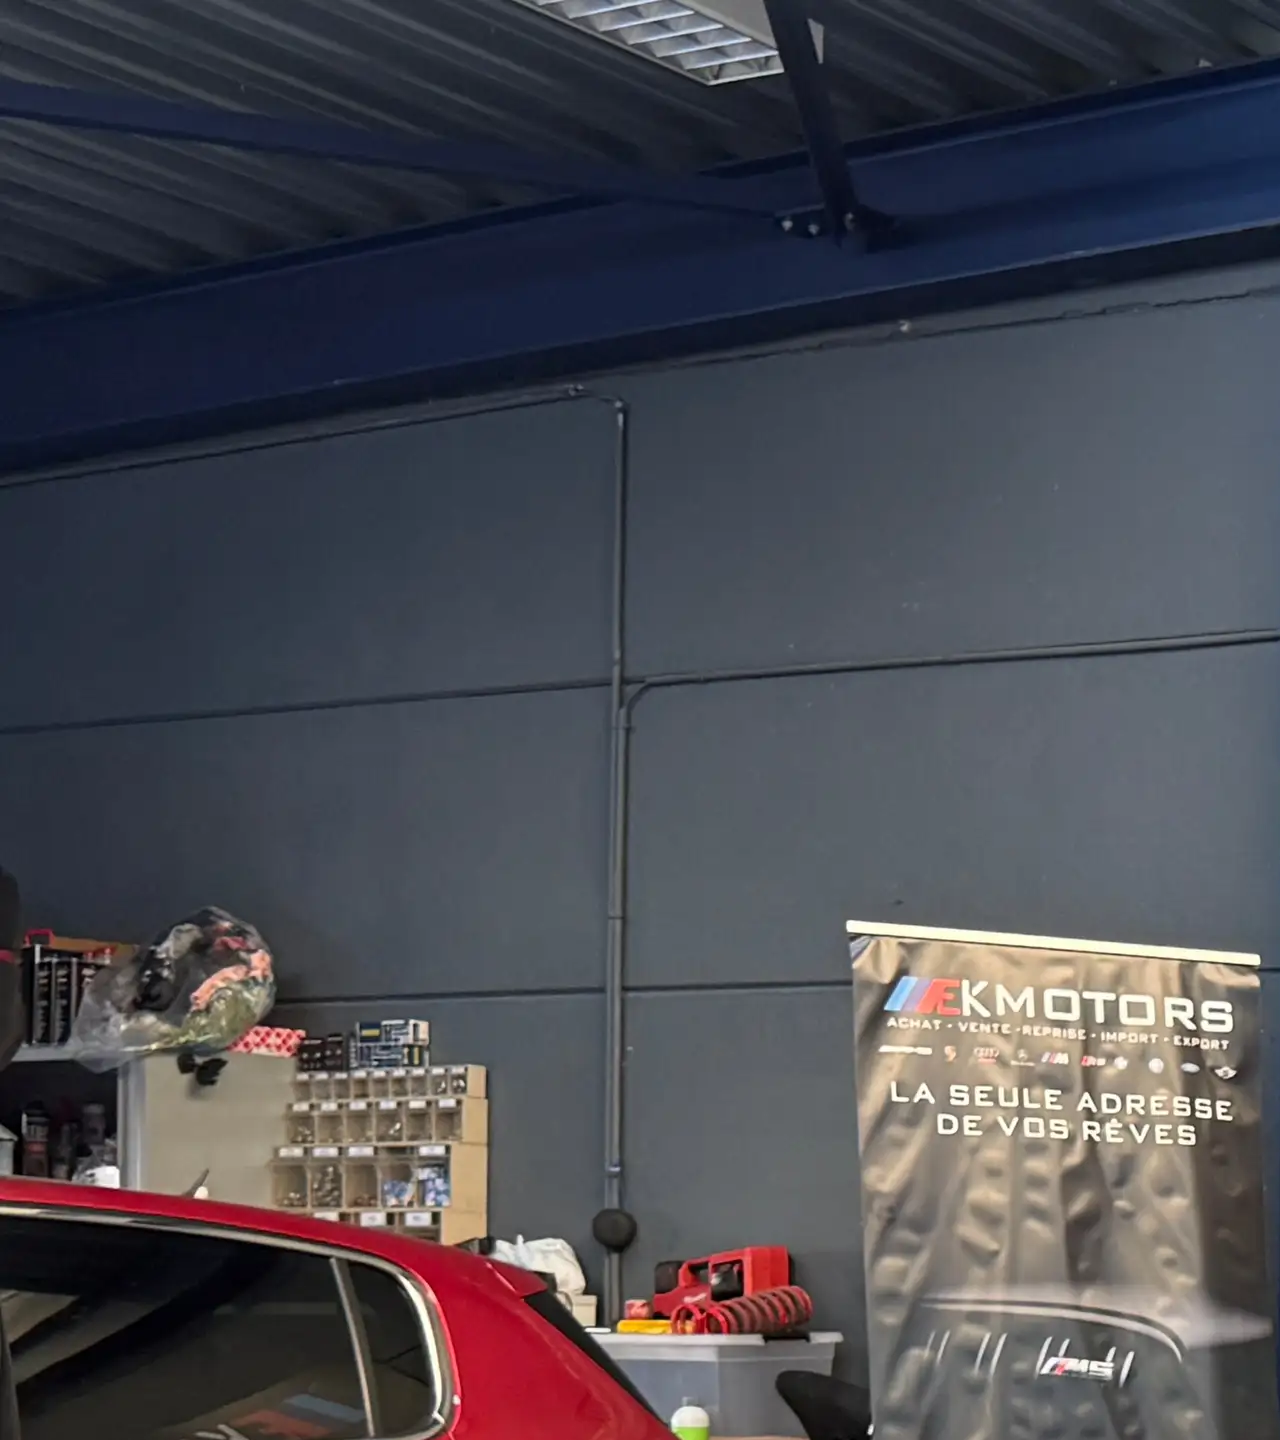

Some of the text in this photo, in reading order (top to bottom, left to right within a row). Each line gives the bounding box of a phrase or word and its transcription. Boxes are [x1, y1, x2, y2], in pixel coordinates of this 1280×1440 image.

[887, 1017, 941, 1031] ACHAT
[958, 1021, 1011, 1034] VENTE
[1100, 1031, 1159, 1045] IMPORT
[1173, 1037, 1230, 1051] EXPORT
[890, 1081, 1234, 1122] LA SEULE ADRESSE
[937, 1114, 1197, 1147] DE VOS RÊVES
